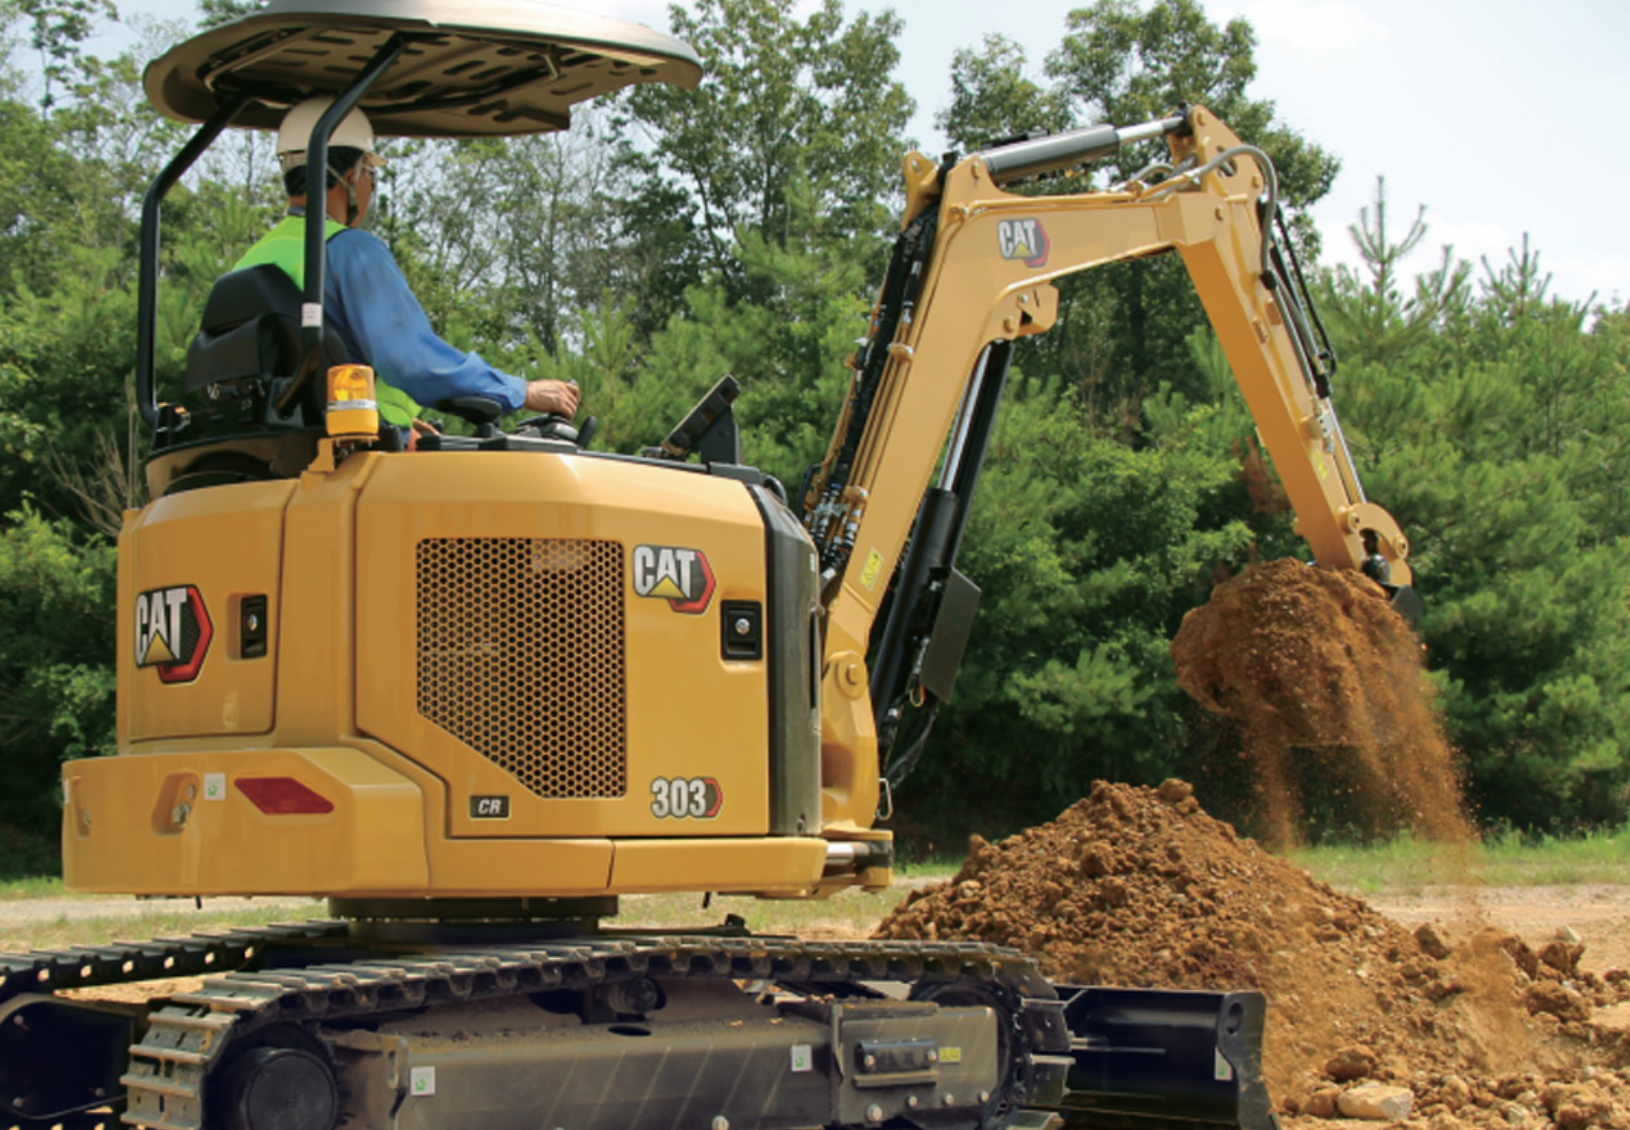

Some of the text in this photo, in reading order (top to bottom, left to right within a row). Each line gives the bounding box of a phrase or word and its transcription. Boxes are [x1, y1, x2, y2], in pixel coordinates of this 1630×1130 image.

[999, 219, 1036, 258] CAT
[634, 546, 695, 598] CAT
[135, 587, 187, 666] CAT
[478, 798, 502, 815] CR
[652, 778, 706, 816] 303
